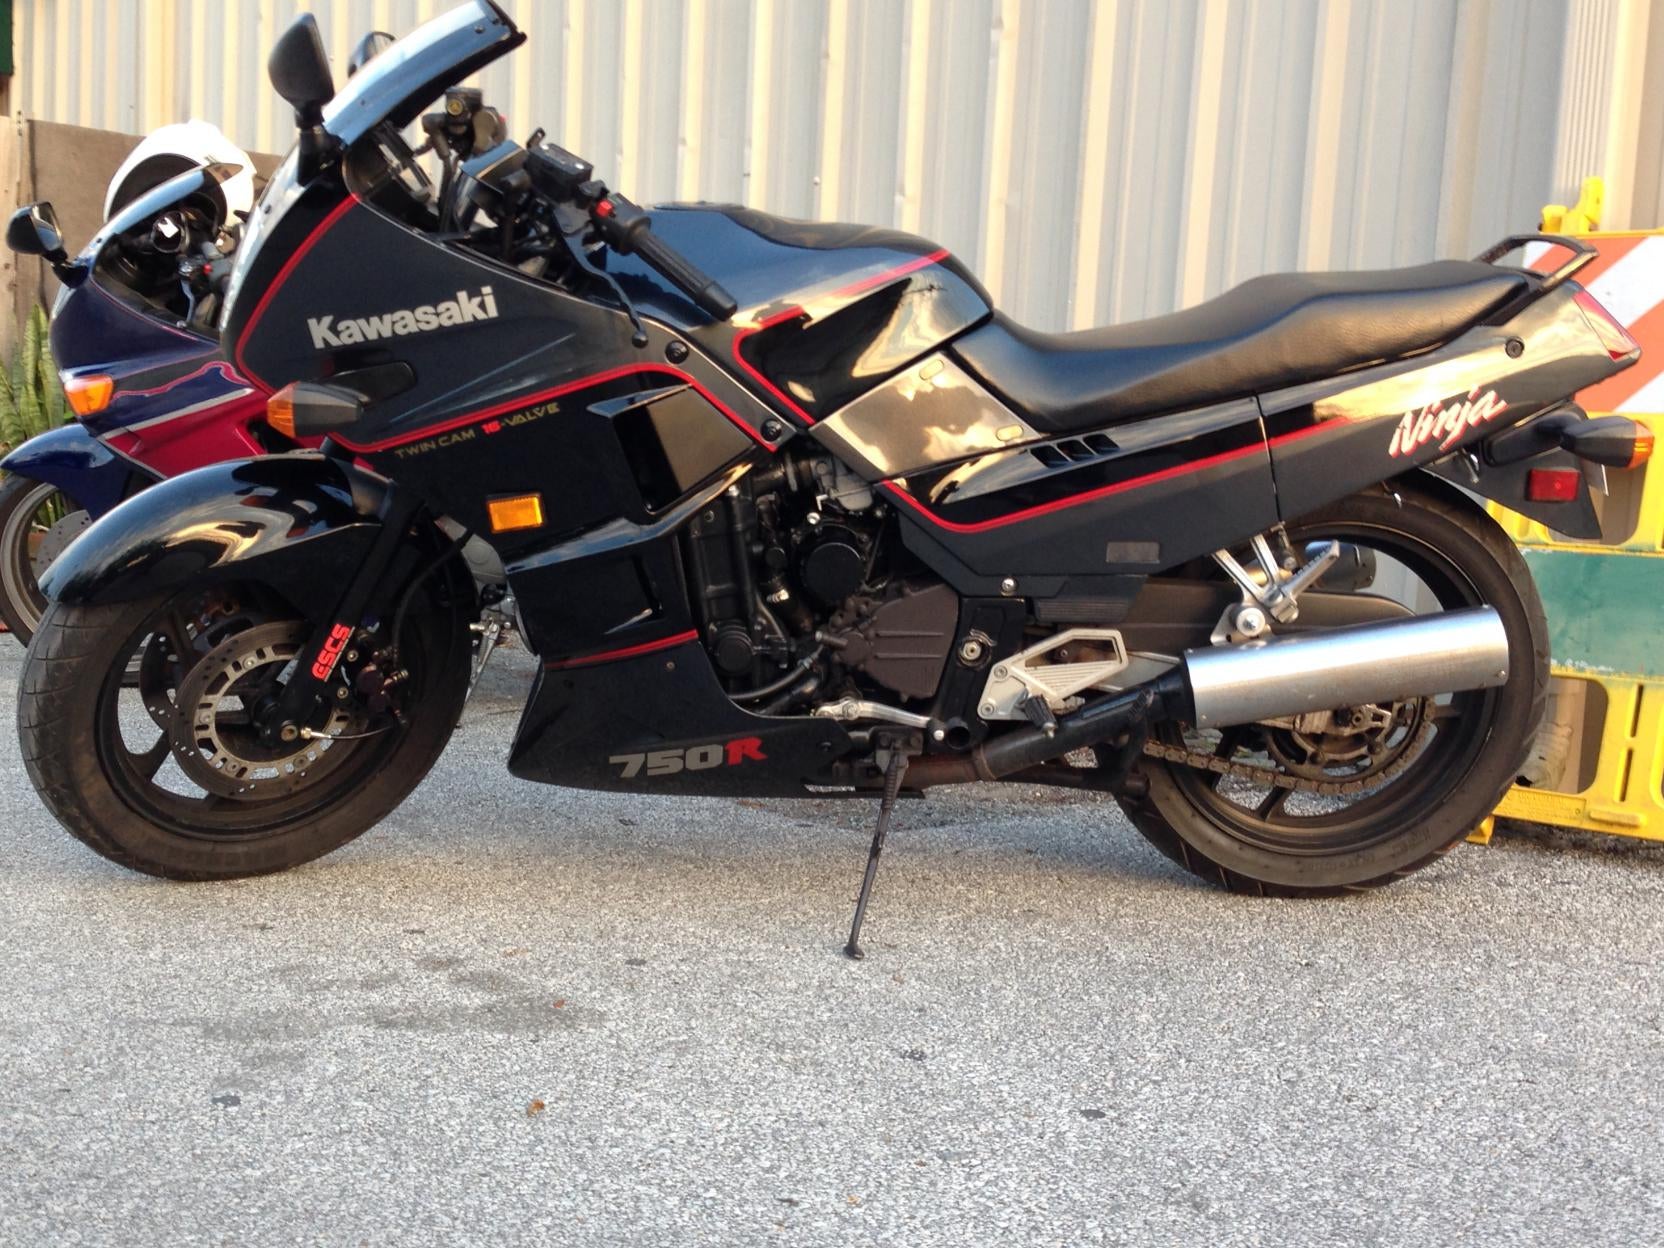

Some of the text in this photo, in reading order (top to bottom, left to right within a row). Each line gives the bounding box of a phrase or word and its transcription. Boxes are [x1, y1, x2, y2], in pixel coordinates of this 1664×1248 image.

[307, 285, 498, 349] Kawasaki
[394, 402, 560, 459] TWIN CAM 16-VALVE
[1388, 383, 1508, 458] Ninja
[609, 737, 768, 778] 750R
